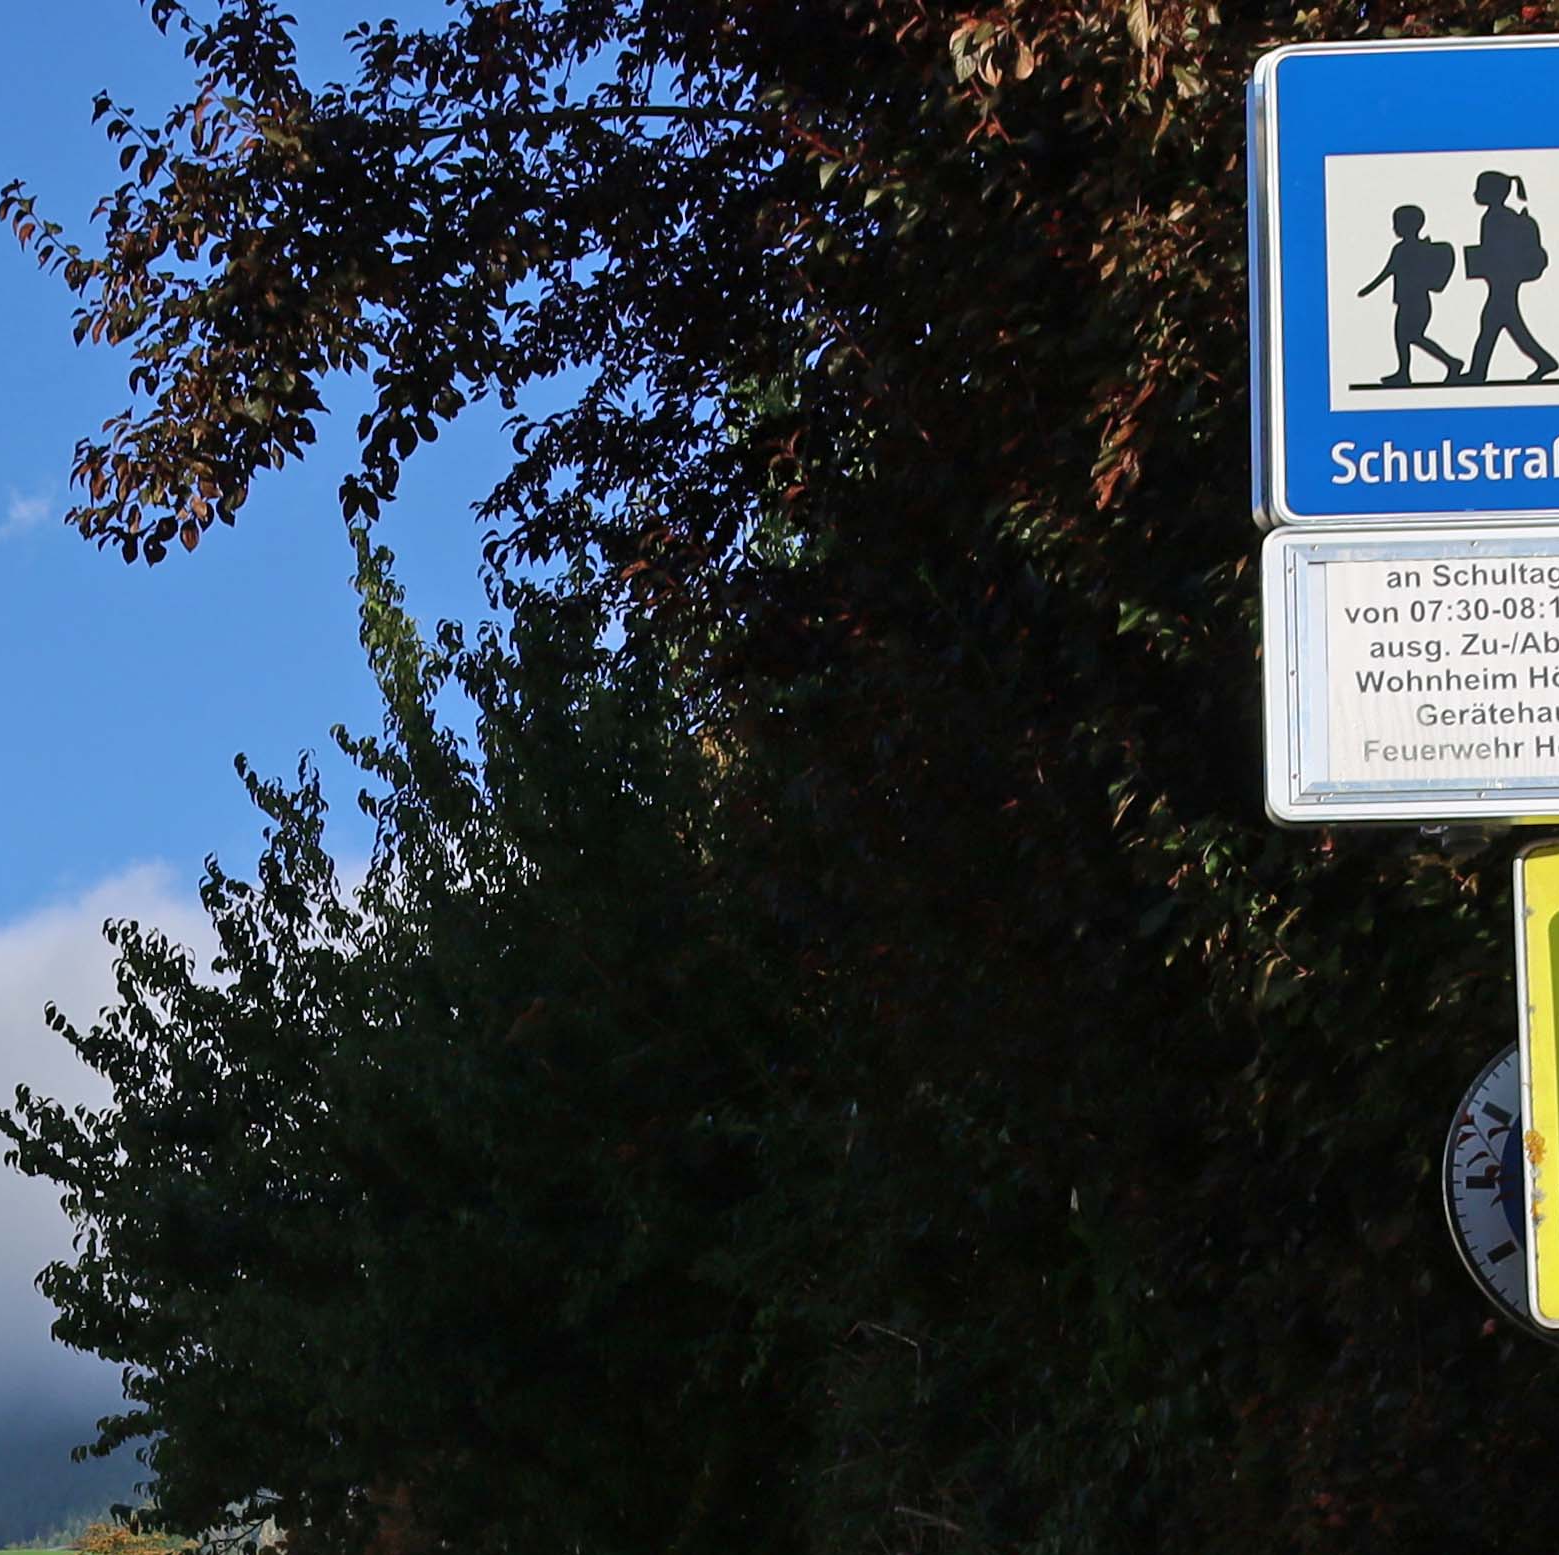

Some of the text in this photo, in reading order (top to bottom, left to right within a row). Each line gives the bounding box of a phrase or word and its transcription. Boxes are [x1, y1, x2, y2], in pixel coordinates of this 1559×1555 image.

[1386, 571, 1422, 589] an
[1344, 605, 1400, 624] von
[1369, 638, 1452, 663] ausg.
[1354, 668, 1518, 694] Wohnheim
[1362, 736, 1525, 763] Feuerwehr
